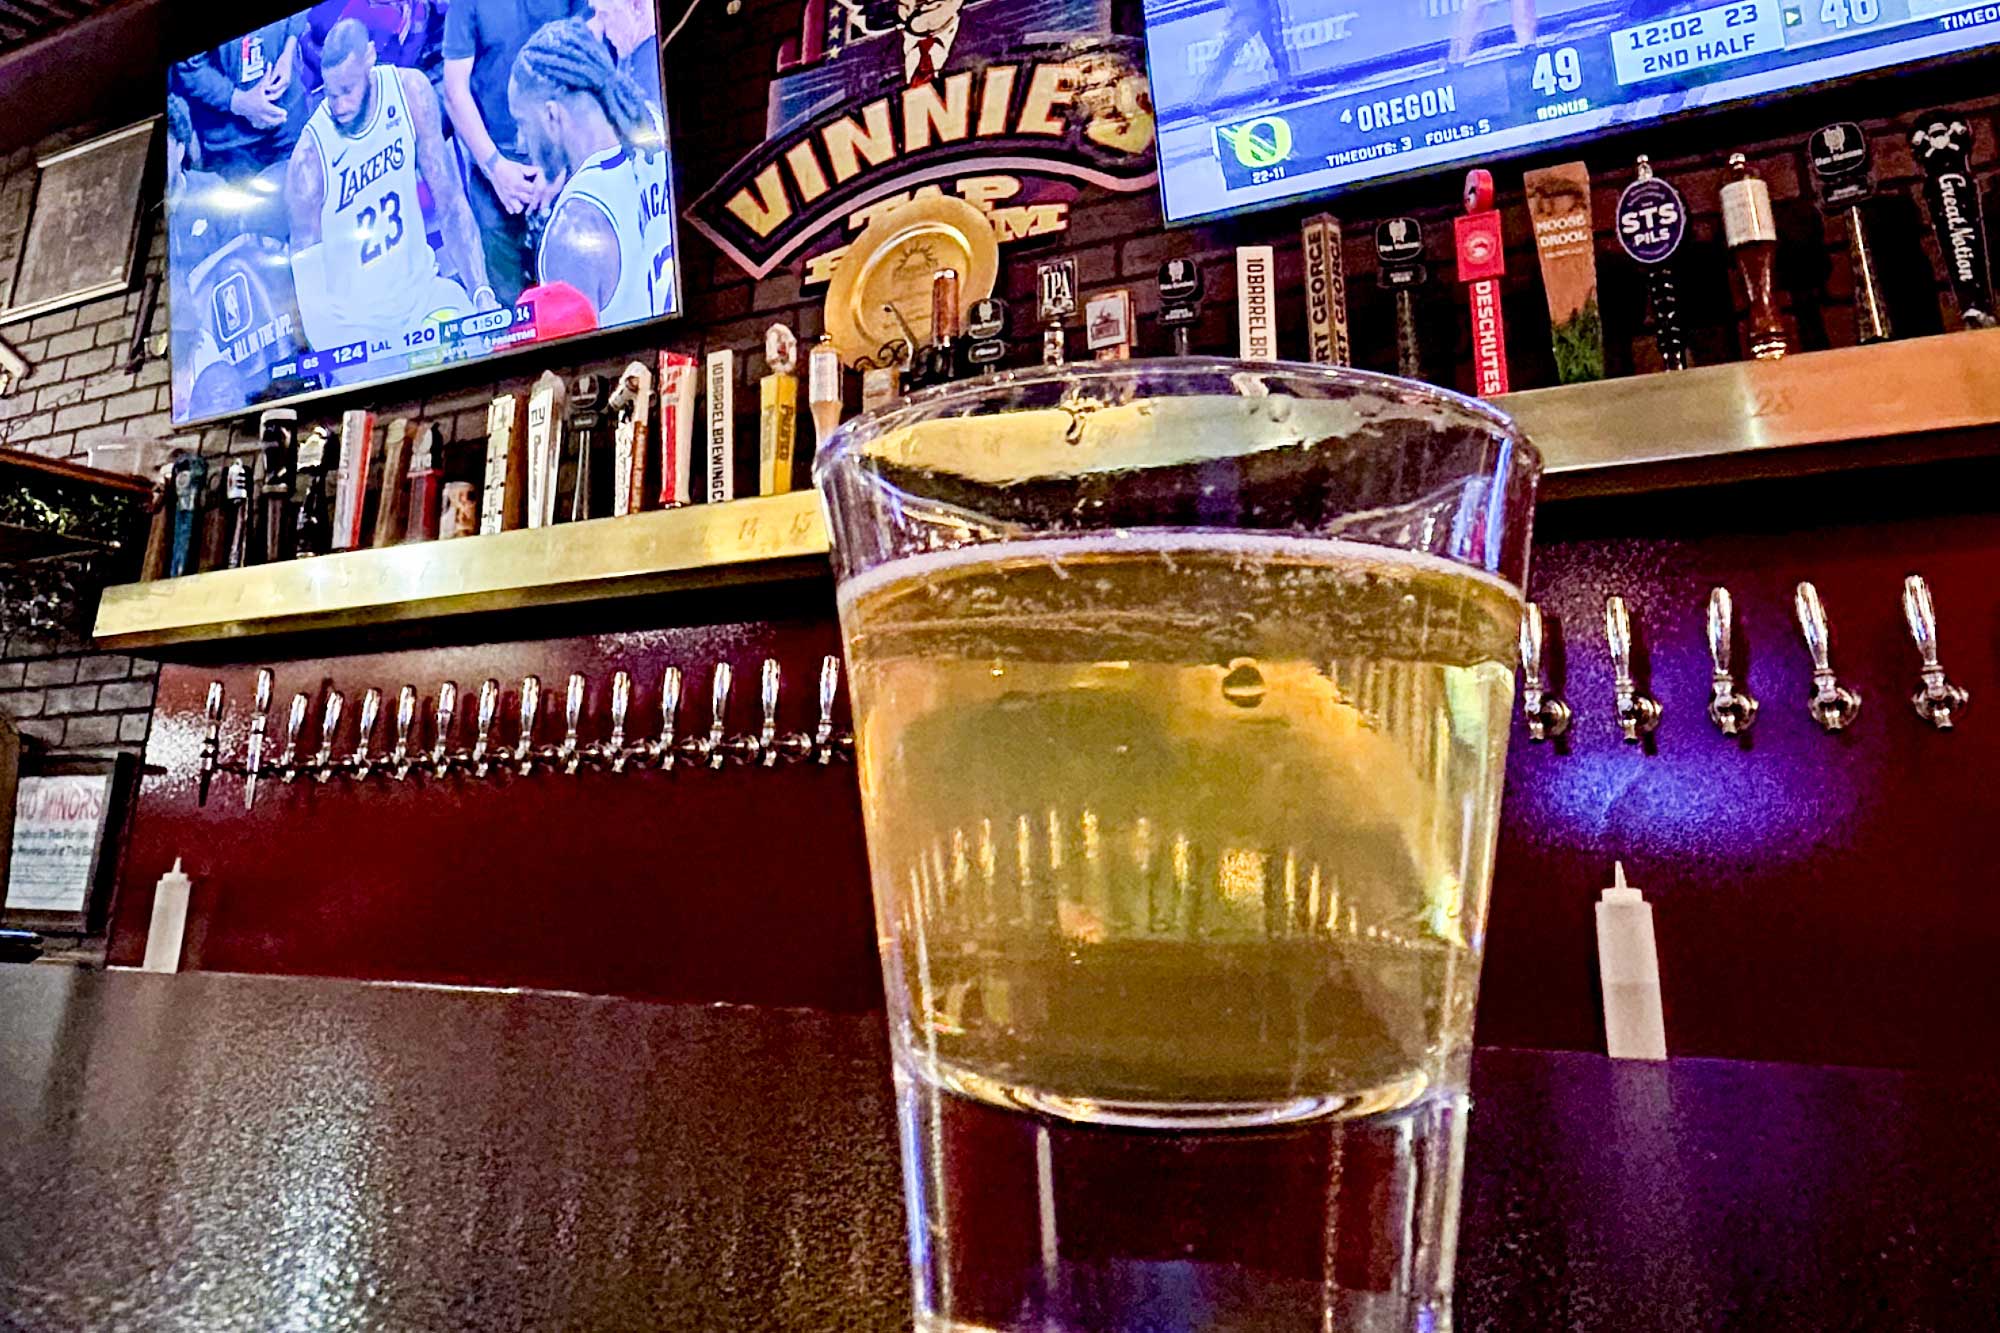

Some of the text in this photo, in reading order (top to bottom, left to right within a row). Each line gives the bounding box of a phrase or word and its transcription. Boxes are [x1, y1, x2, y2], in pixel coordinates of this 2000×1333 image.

[1630, 3, 1759, 50] 12:02 23
[1530, 46, 1582, 97] 49
[1643, 33, 1756, 74] 2ND HALF
[1357, 84, 1456, 132] OREGON
[1537, 98, 1589, 121] BONUS
[1326, 139, 1398, 168] TIMEOUTS:
[1401, 138, 1412, 152] 3
[1425, 124, 1476, 146] FOULS:
[335, 137, 405, 214] LAKERS
[356, 190, 404, 265] 23
[1536, 213, 1586, 233] MOOSE
[1539, 230, 1588, 248] DROOL
[1621, 202, 1678, 234] STS
[1633, 227, 1670, 246] PILS
[1043, 270, 1070, 300] IPA
[332, 345, 364, 363] 124
[371, 340, 392, 353] LAL
[403, 328, 435, 346] 120
[516, 306, 531, 322] 14
[1475, 280, 1501, 395] DESCHUTES
